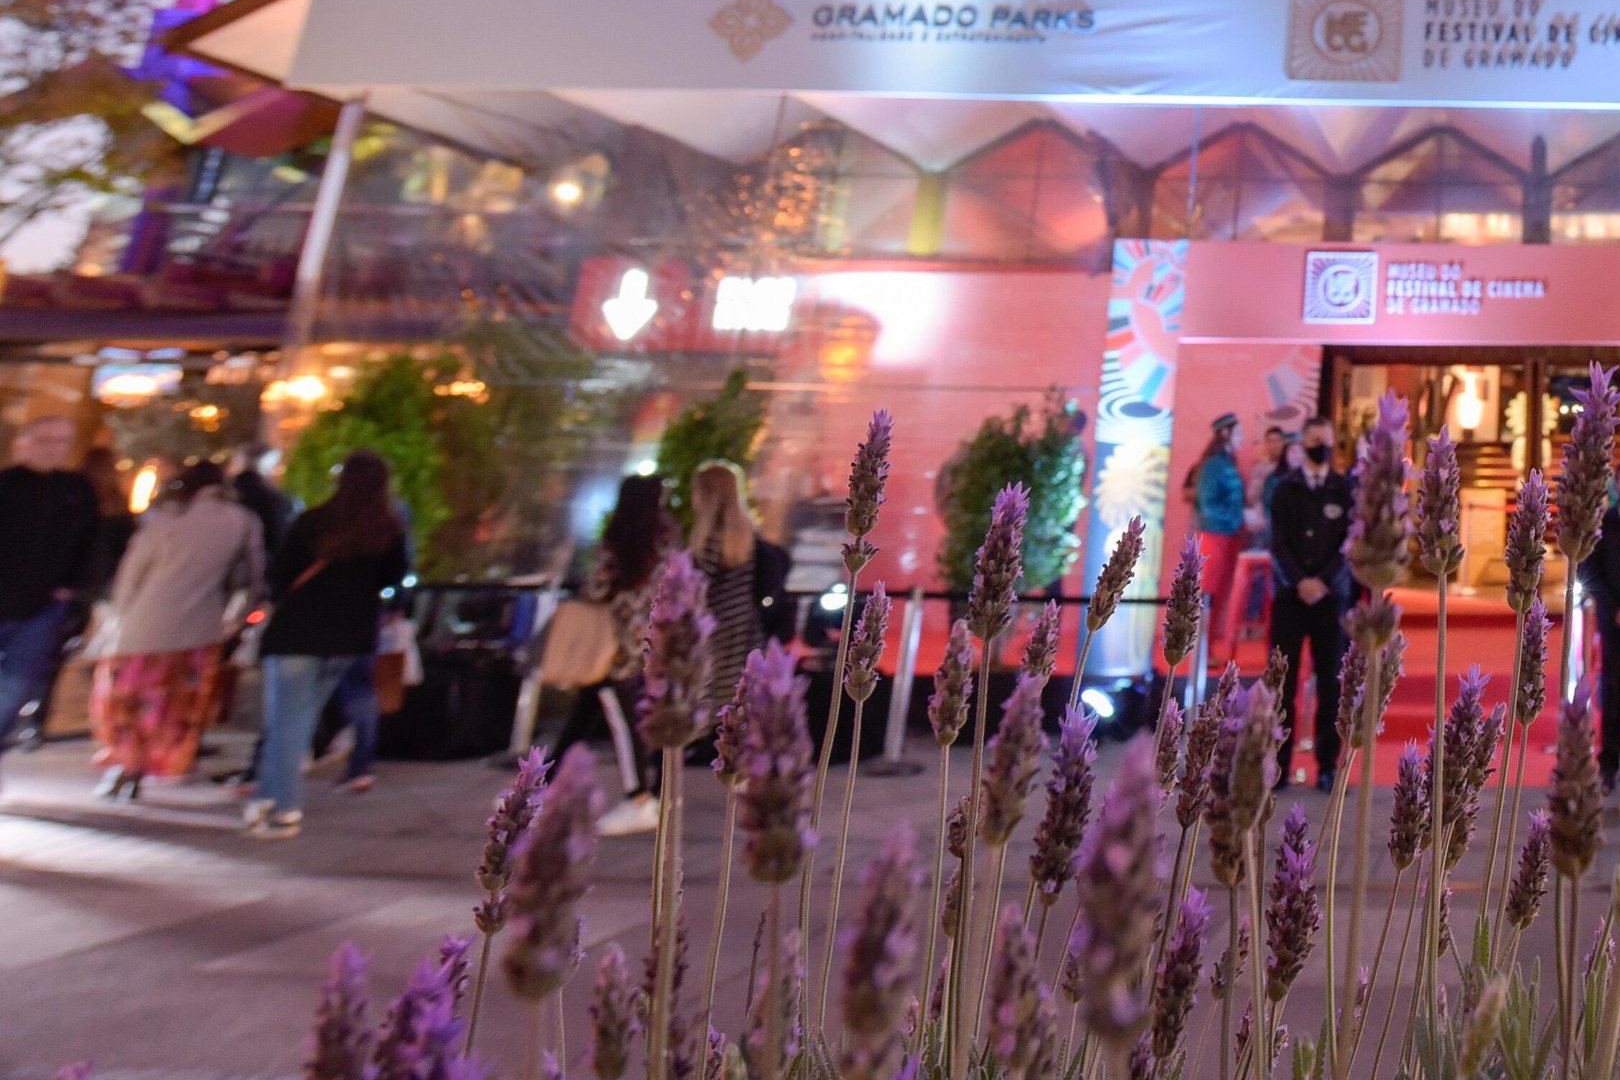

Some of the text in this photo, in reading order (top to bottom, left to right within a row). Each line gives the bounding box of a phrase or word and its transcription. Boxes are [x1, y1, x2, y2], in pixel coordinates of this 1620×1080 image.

[812, 4, 1096, 29] GRAMADO PARKS
[1423, 22, 1532, 43] FESTIVAL
[1547, 22, 1575, 43] DE
[1423, 48, 1575, 69] DE GRAMADO
[1387, 263, 1462, 281] MUSEU DO
[1387, 279, 1545, 299] FESTIVAL DE CINEMA
[1410, 297, 1482, 316] GRAMADO
